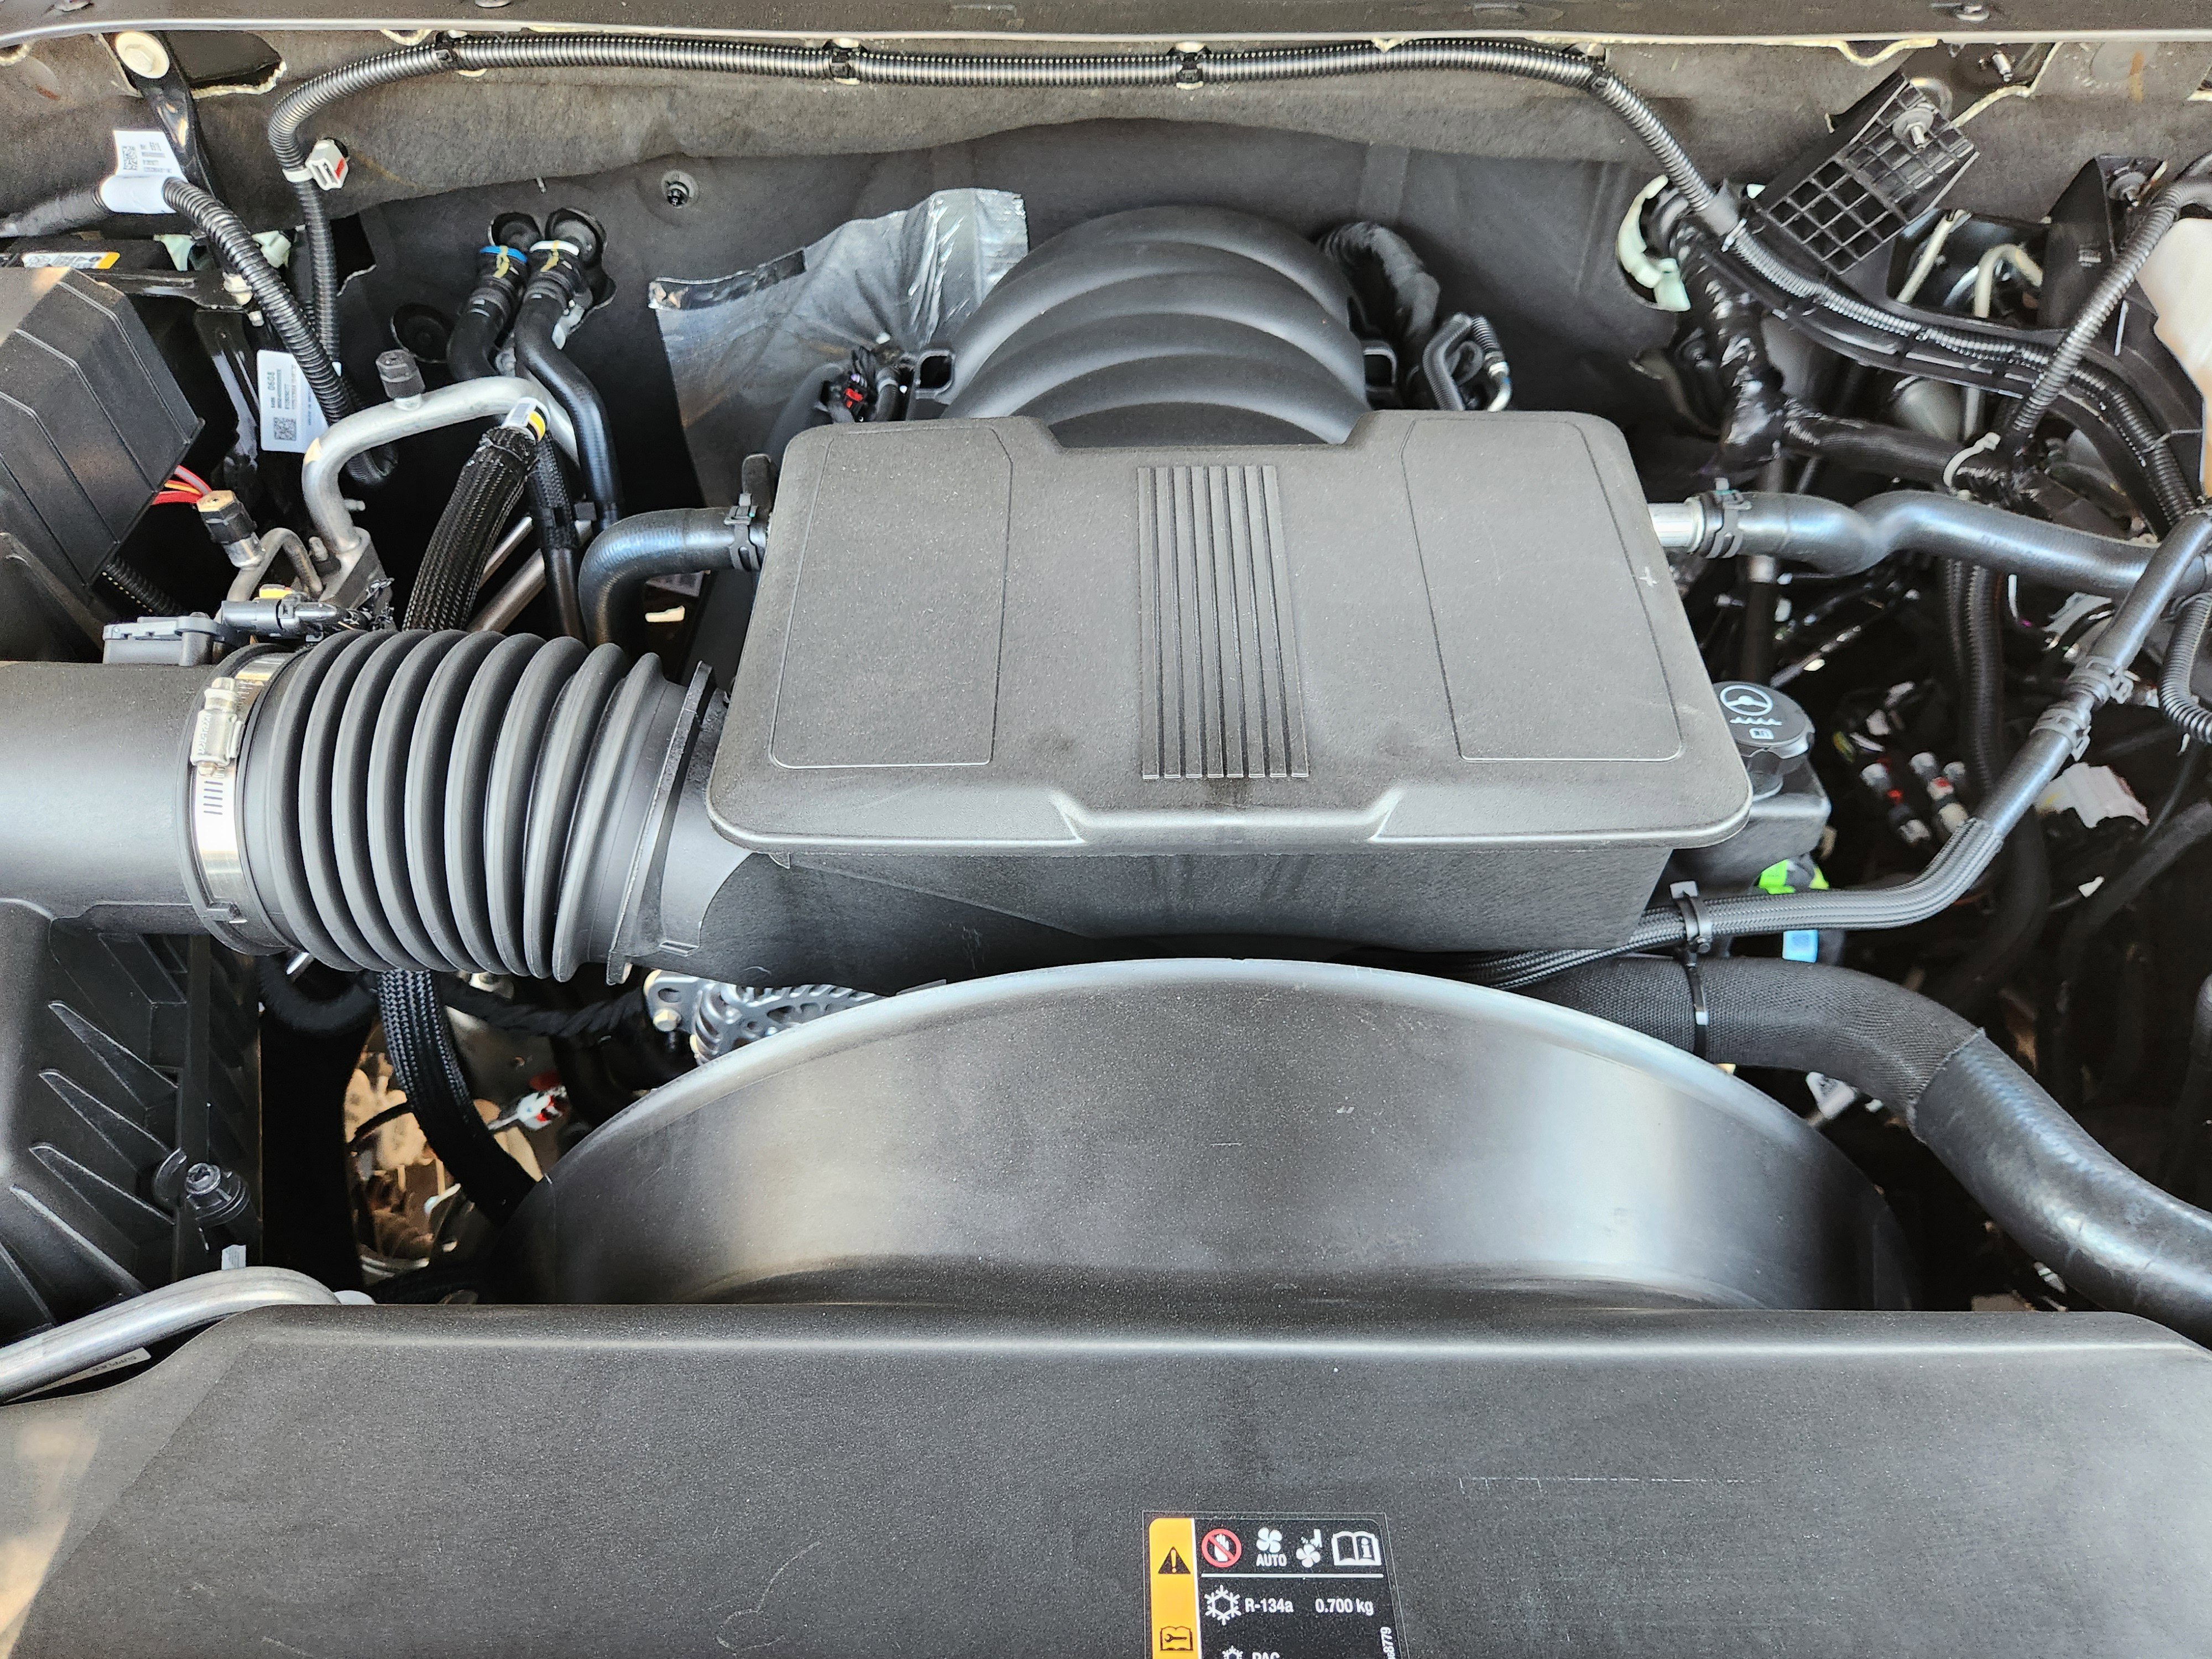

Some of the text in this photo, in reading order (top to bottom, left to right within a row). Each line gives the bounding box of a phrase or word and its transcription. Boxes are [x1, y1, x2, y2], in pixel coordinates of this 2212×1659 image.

[1256, 1553, 1287, 1567] AUTO
[1245, 1598, 1374, 1616] R-134a 0.700 kg
